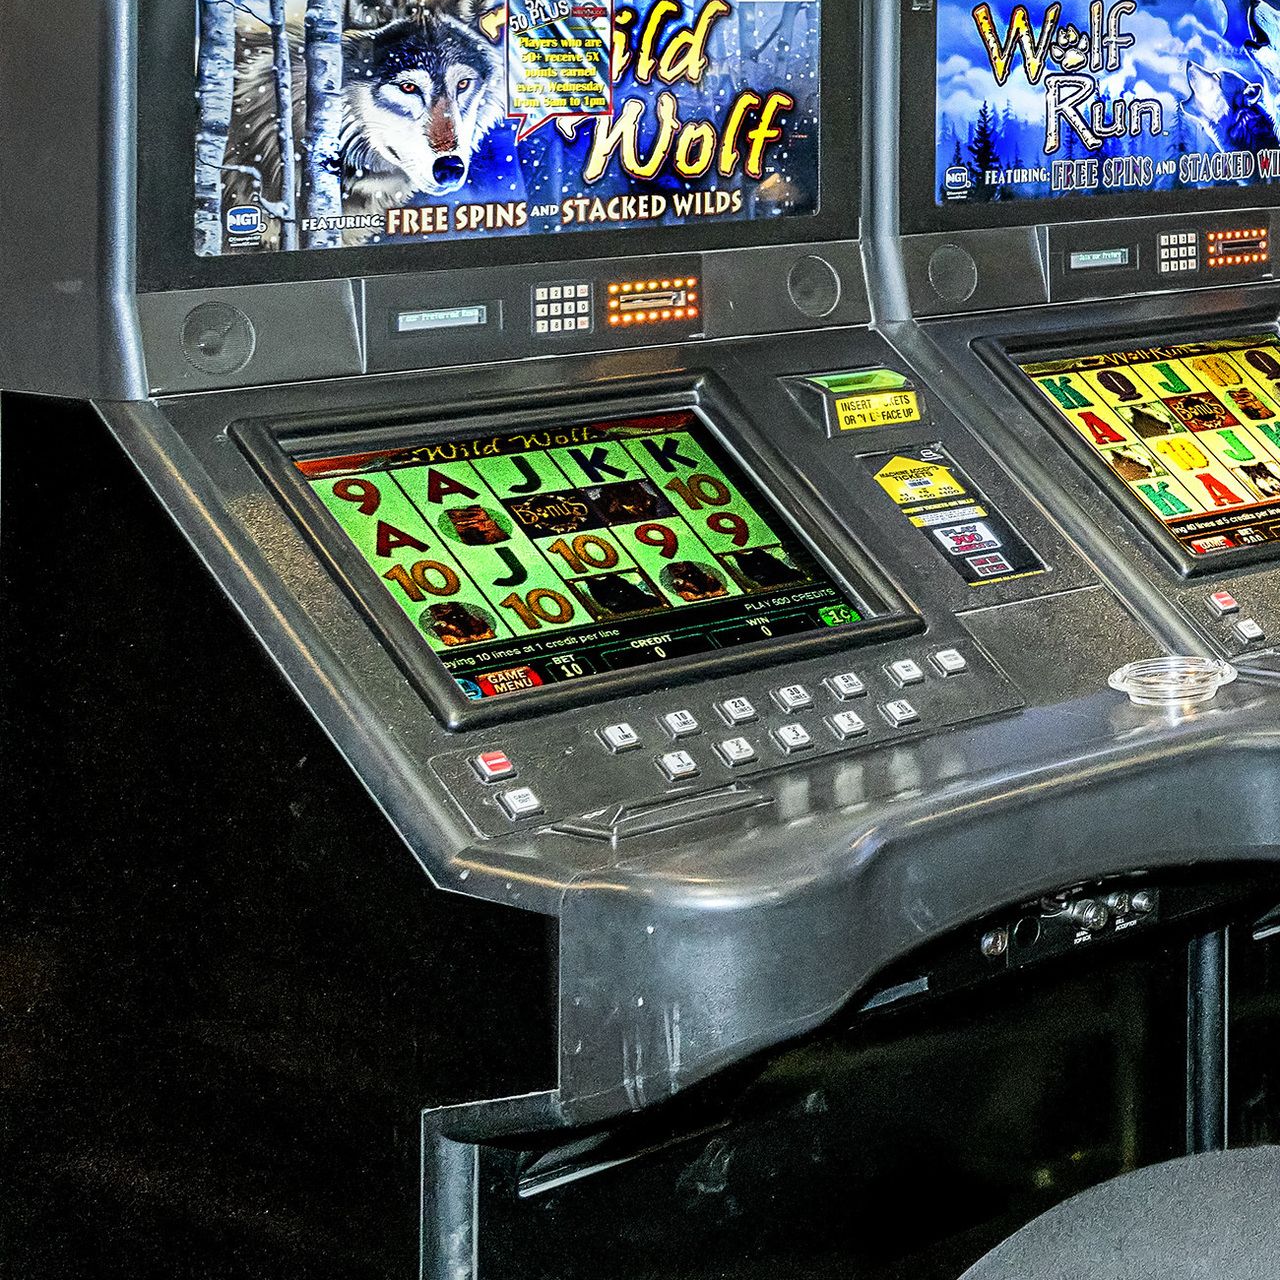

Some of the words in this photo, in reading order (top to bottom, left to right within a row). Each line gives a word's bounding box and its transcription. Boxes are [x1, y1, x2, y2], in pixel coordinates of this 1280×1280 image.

[530, 0, 569, 25] PLUS
[520, 38, 557, 49] Players
[561, 39, 582, 47] who
[585, 39, 602, 47] are
[545, 53, 583, 62] receive
[586, 52, 600, 61] 5X
[561, 67, 596, 76] earned
[549, 82, 604, 93] Wednesday
[570, 97, 580, 106] to
[1044, 73, 1163, 154] Run
[556, 91, 794, 184] Wolf
[985, 169, 1050, 184] FEATURING:
[1052, 159, 1098, 191] FREE
[1102, 155, 1153, 188] SPINS
[1156, 162, 1176, 175] AND
[1179, 151, 1254, 182] STACKED
[302, 215, 385, 232] FEATURING:
[387, 207, 448, 235] FREE
[455, 202, 527, 231] SPINS
[530, 204, 558, 216] AND
[563, 194, 665, 224] STACKED
[674, 189, 742, 217] WILDS
[841, 400, 871, 412] INSERT
[844, 415, 856, 425] OR
[881, 410, 903, 420] FACE
[904, 408, 913, 418] UP
[416, 438, 500, 462] Wild
[332, 478, 381, 516] 9
[427, 468, 481, 504] A
[507, 456, 544, 493] J
[571, 449, 626, 483] K
[647, 436, 698, 472] K
[893, 472, 934, 482] TICKETS
[548, 535, 618, 574] 10
[383, 560, 461, 601] 10
[744, 599, 770, 612] PLAY
[791, 586, 835, 603] CREDITS
[499, 588, 575, 630] 10
[745, 616, 769, 627] WIN
[475, 652, 489, 665] 10
[491, 646, 520, 662] lines
[544, 637, 577, 651] credit
[598, 627, 619, 640] line
[630, 634, 673, 649] CREDIT
[552, 655, 575, 665] BET
[487, 669, 527, 684] GAME
[560, 663, 583, 678] 10
[493, 678, 533, 694] MENU
